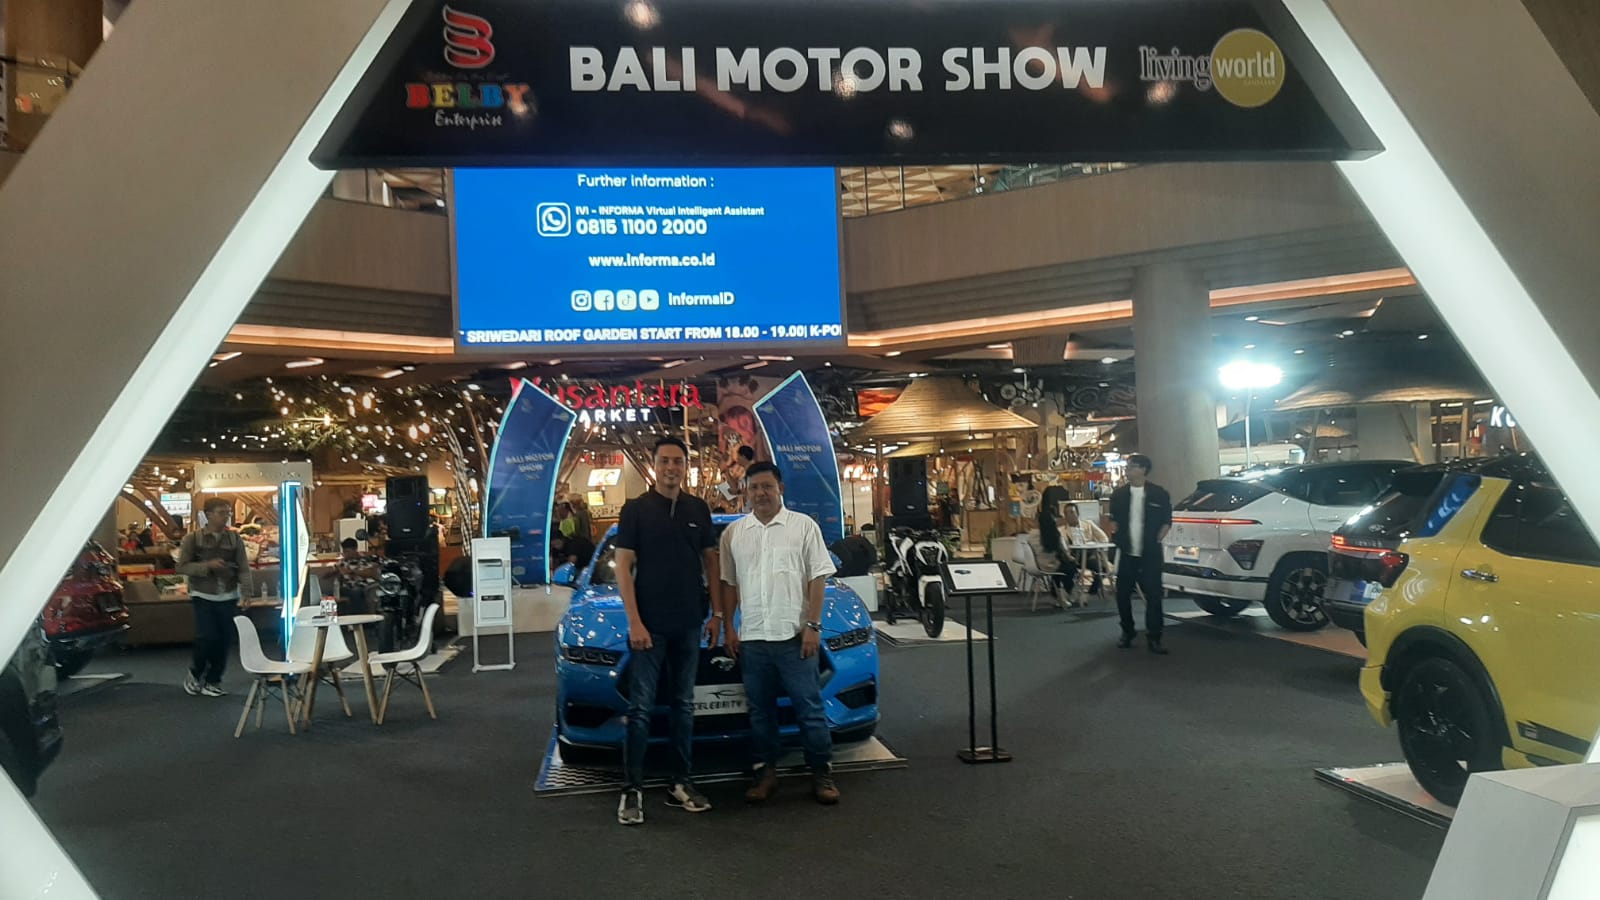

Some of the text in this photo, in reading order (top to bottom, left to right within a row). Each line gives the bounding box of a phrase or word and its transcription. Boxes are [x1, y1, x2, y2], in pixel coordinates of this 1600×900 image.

[569, 46, 1107, 92] BALI MOTOR SHOW
[1139, 46, 1276, 91] living world
[406, 83, 529, 112] BELBY
[435, 109, 503, 130] Enterprise
[577, 174, 627, 187] Further
[631, 174, 707, 188] information
[575, 206, 589, 215] IVI
[599, 206, 644, 215] INFORMA
[645, 206, 676, 216] Virtual
[677, 206, 722, 217] Intelligent
[723, 206, 765, 216] Assistant
[575, 218, 708, 235] 0815 1100 2000
[588, 252, 716, 268] www.informa.co.id
[466, 329, 542, 343] SRIWEDARI
[544, 328, 581, 342] ROOF
[582, 327, 638, 341] GARDEN
[639, 326, 683, 340] START
[684, 326, 723, 339] FROM
[725, 325, 760, 339] 18.00
[578, 409, 651, 424] ARKET
[776, 444, 822, 452] BALI MOTOR
[505, 452, 554, 464] BALI MOTOR
